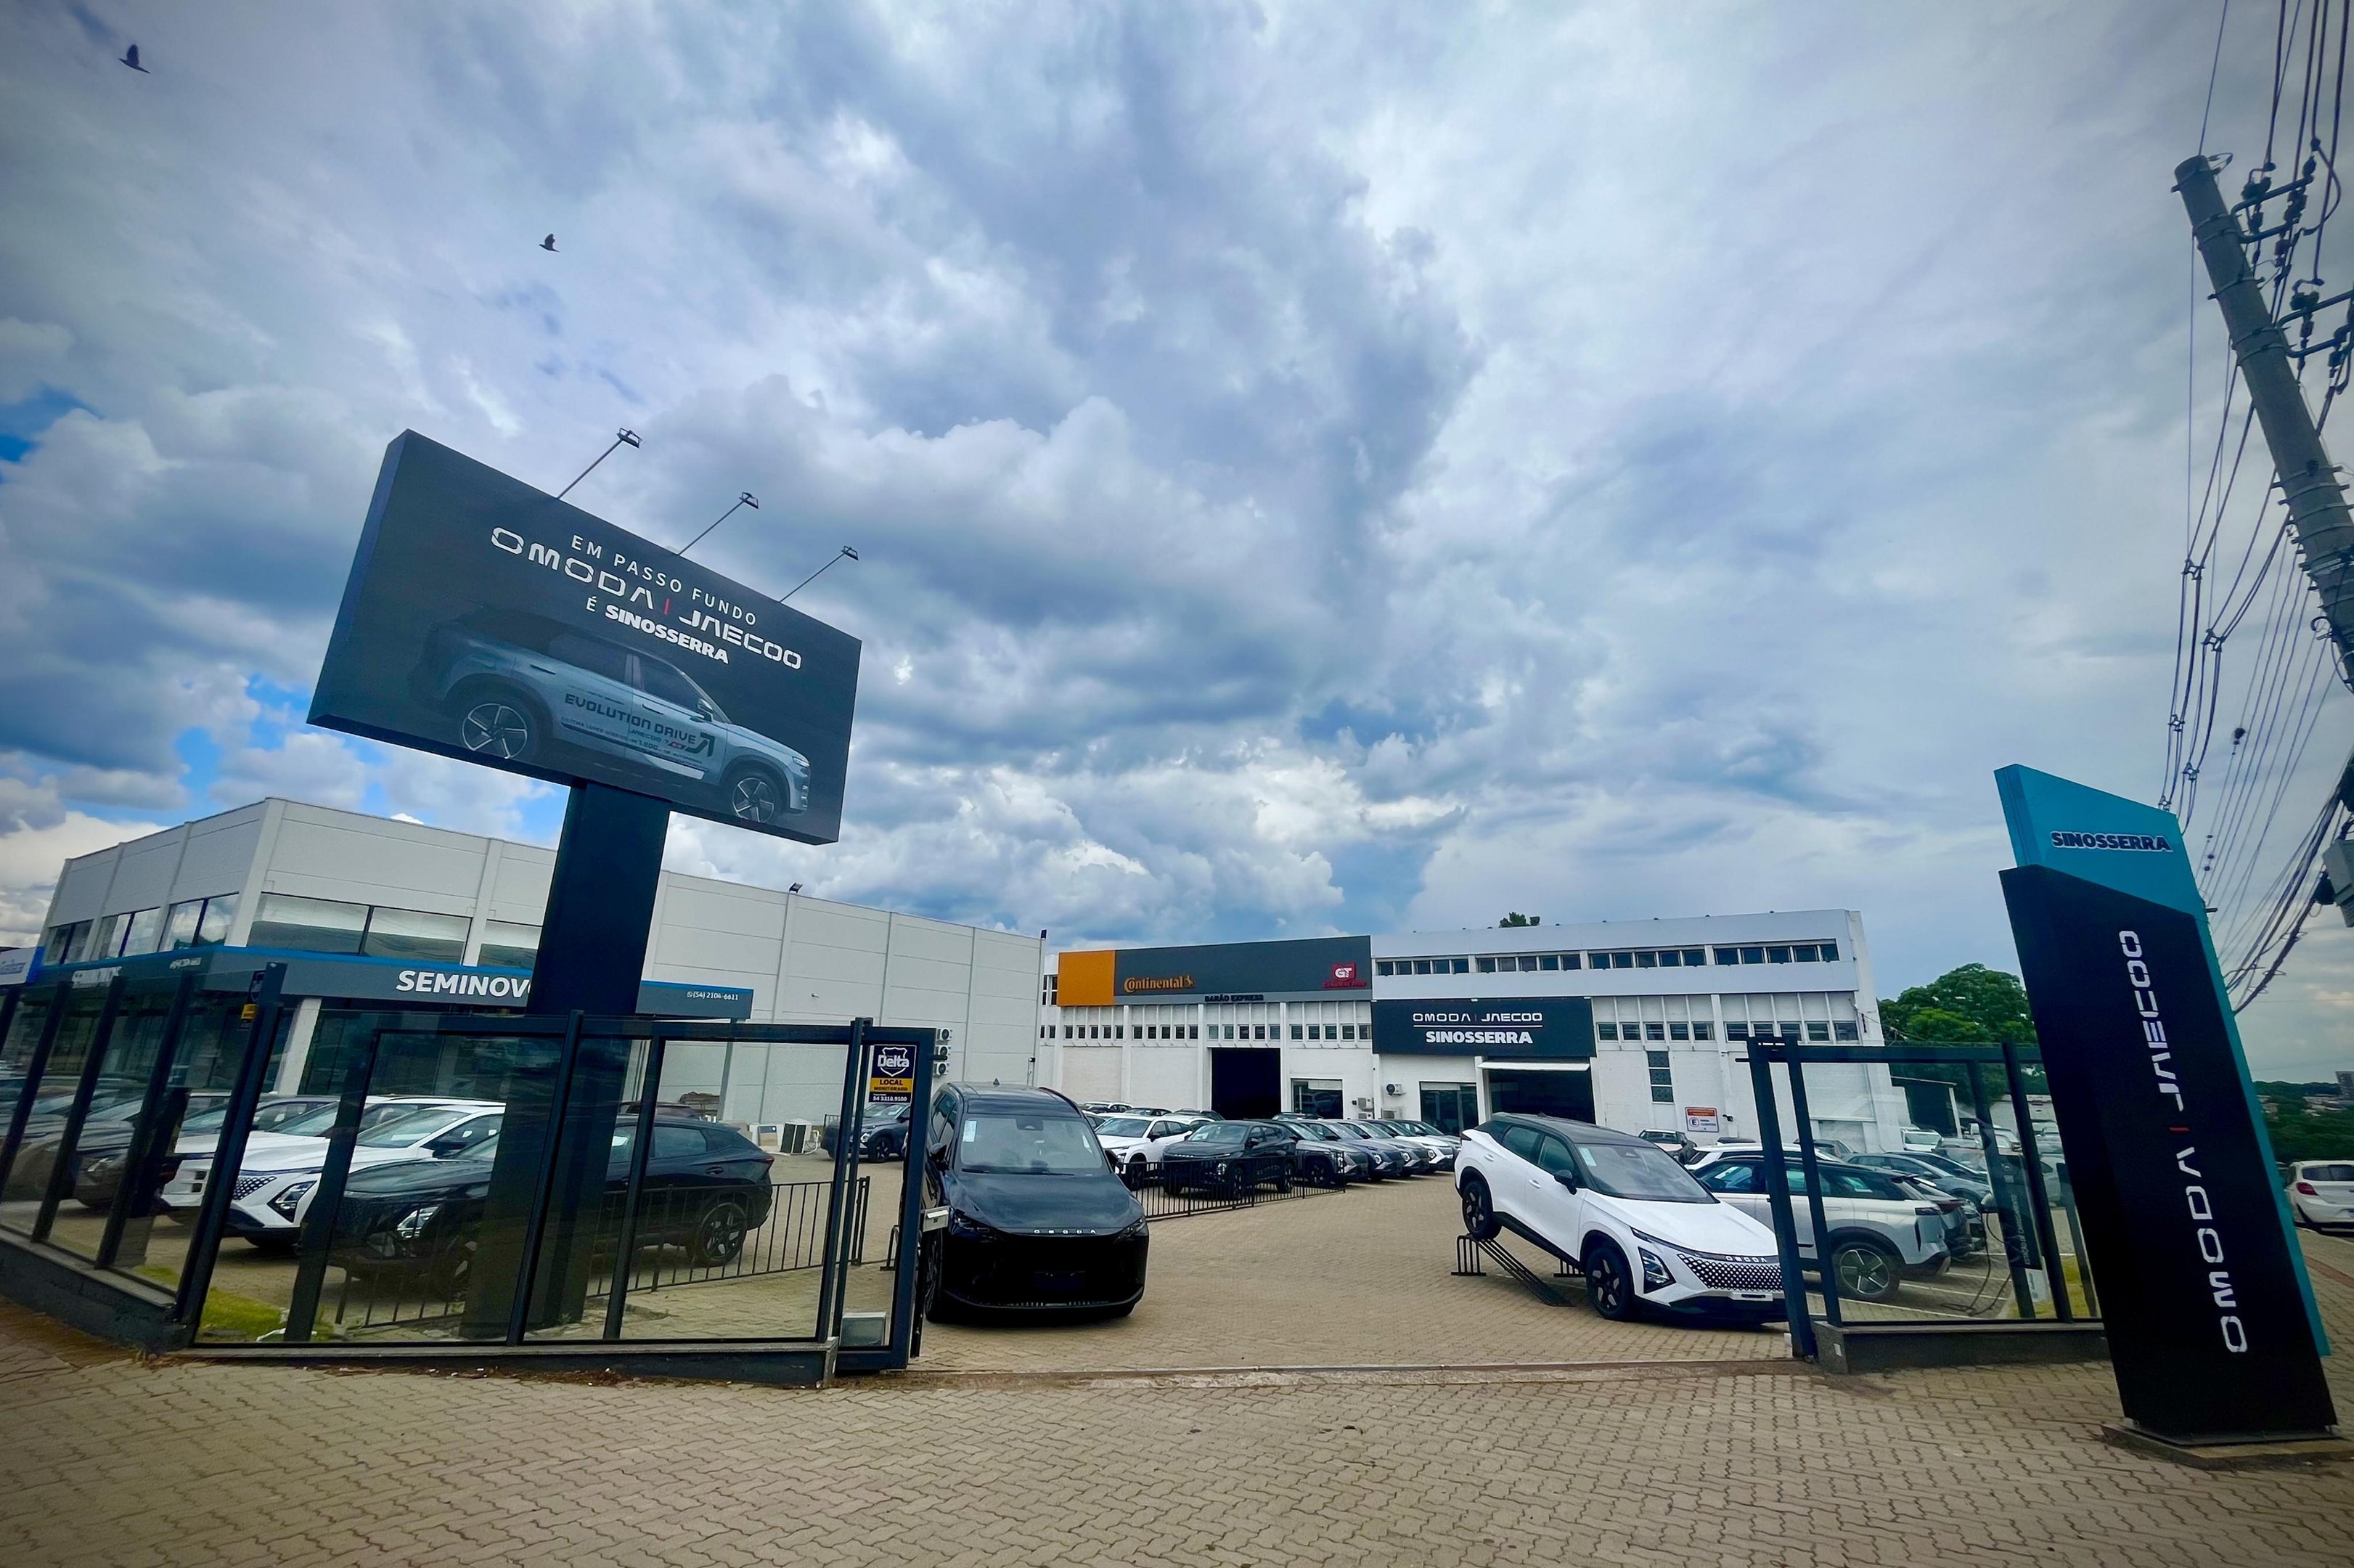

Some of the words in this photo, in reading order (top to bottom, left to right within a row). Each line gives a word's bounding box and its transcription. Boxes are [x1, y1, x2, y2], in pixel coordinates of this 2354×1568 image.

[571, 534, 602, 559] EM
[613, 553, 682, 592] PASSO
[692, 587, 756, 626] FUNDO
[491, 527, 653, 610] OMODA
[678, 610, 802, 669] JAECOO
[586, 596, 597, 612] É
[605, 604, 730, 664] SINOSSERRA
[565, 693, 651, 730] EVOLUTION
[654, 724, 696, 745] DRIVE
[2051, 831, 2173, 852] SINOSSERRA
[396, 970, 531, 997] SEMINOV
[1124, 976, 1183, 993] Continental
[1335, 968, 1352, 978] GT
[1413, 1013, 1471, 1022] OMODA
[1481, 1013, 1542, 1022] JAECOO
[2119, 931, 2184, 1112] JAECOO
[1426, 1031, 1533, 1044] SINOSSERRA
[878, 1055, 910, 1067] Delta
[2176, 1147, 2248, 1352] OMODA
